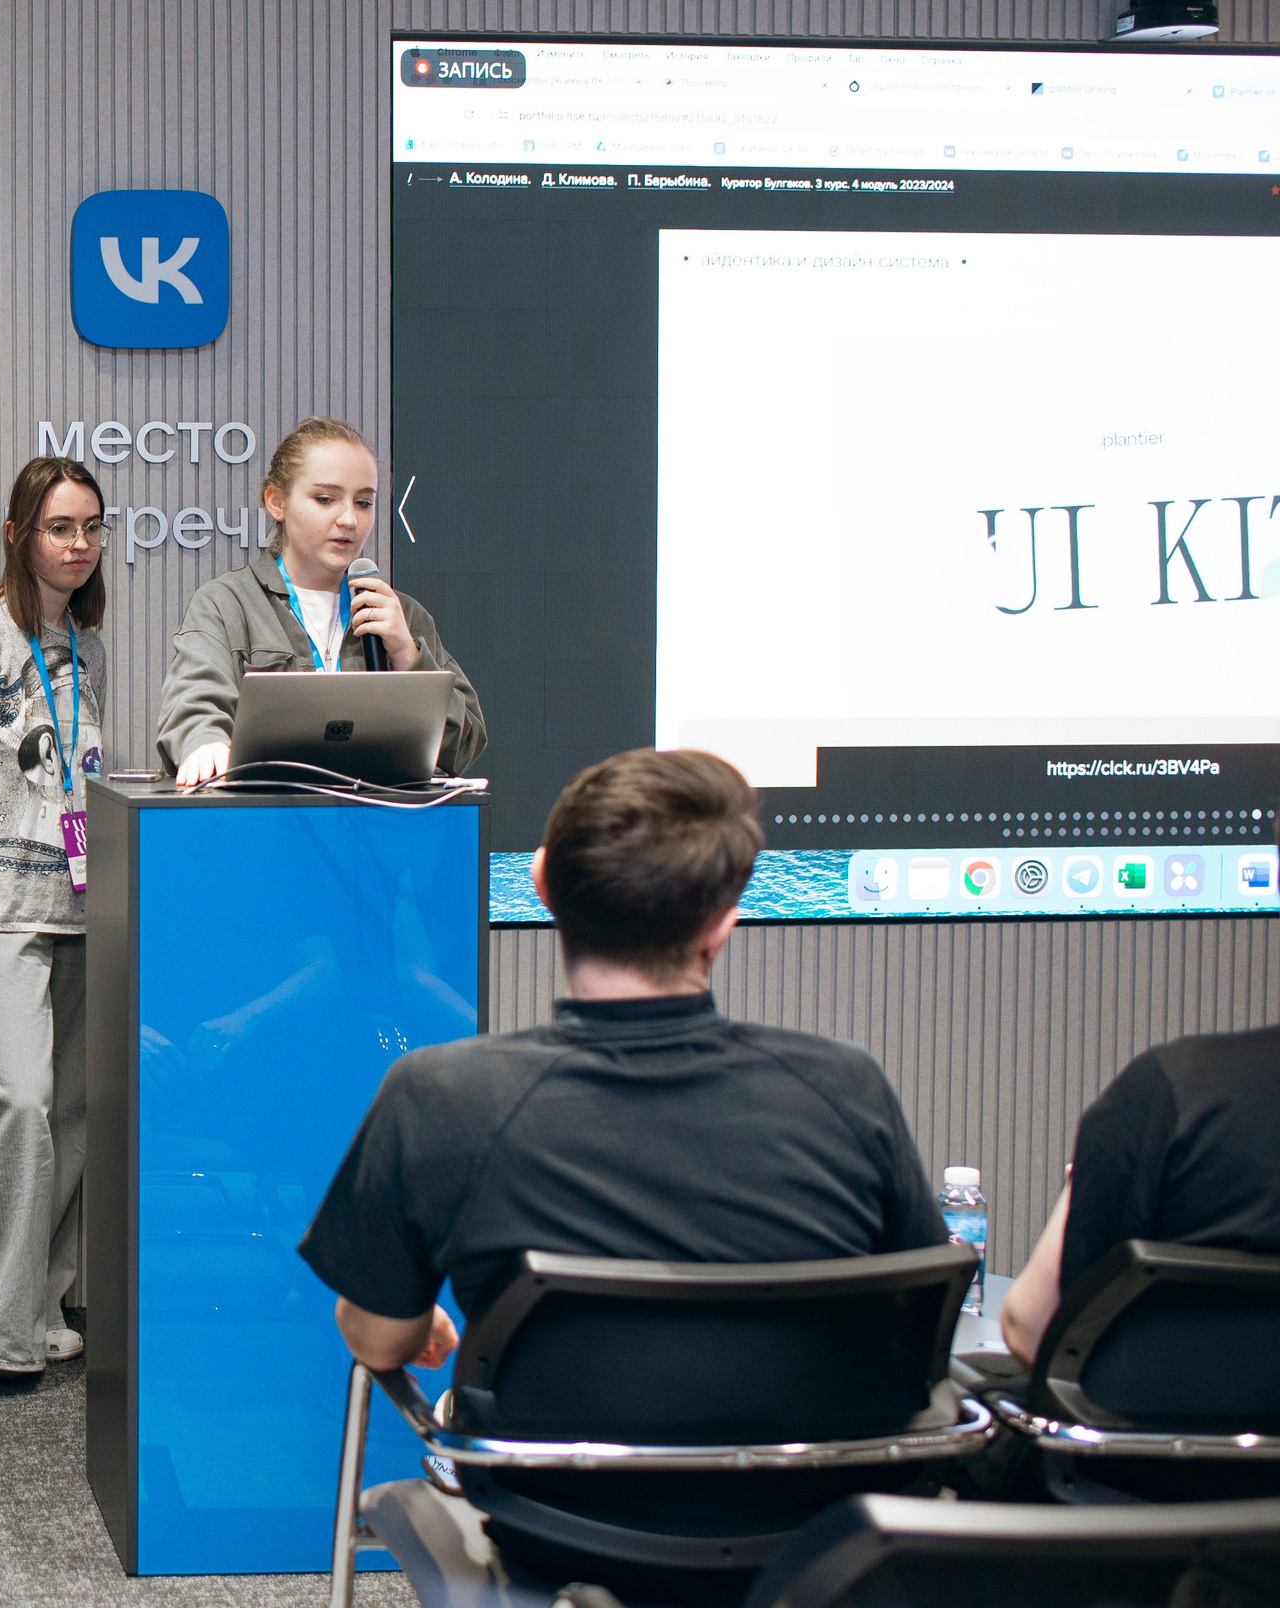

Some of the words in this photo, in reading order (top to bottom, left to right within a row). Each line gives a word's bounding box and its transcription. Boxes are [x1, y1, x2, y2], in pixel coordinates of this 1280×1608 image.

[536, 49, 586, 59] Изменить
[602, 50, 651, 60] Смотреть
[666, 51, 709, 61] История
[724, 53, 770, 63] Закладки
[786, 53, 833, 63] Профили
[921, 55, 963, 66] Справка
[438, 61, 514, 80] ЗАПИСЬ
[1049, 84, 1082, 96] plantier
[1084, 85, 1117, 97] landing
[450, 172, 463, 186] А.
[465, 172, 532, 187] Колодина.
[541, 172, 555, 188] Д.
[558, 173, 618, 187] Климова.
[627, 174, 641, 187] П.
[644, 174, 712, 189] Барыбина.
[721, 177, 762, 189] Куратор
[764, 178, 814, 190] Булгаков.
[815, 178, 822, 189] 3
[852, 179, 859, 190] 4
[861, 180, 898, 192] модуль
[900, 179, 955, 192] 2023/2024
[700, 252, 790, 269] айдентика
[796, 256, 807, 267] и
[812, 253, 950, 270] дизайн-система
[100, 236, 204, 304] VK
[37, 420, 257, 464] место
[1147, 495, 1280, 606] KI
[1046, 759, 1220, 778] https://clck.ru/3BV4Pa
